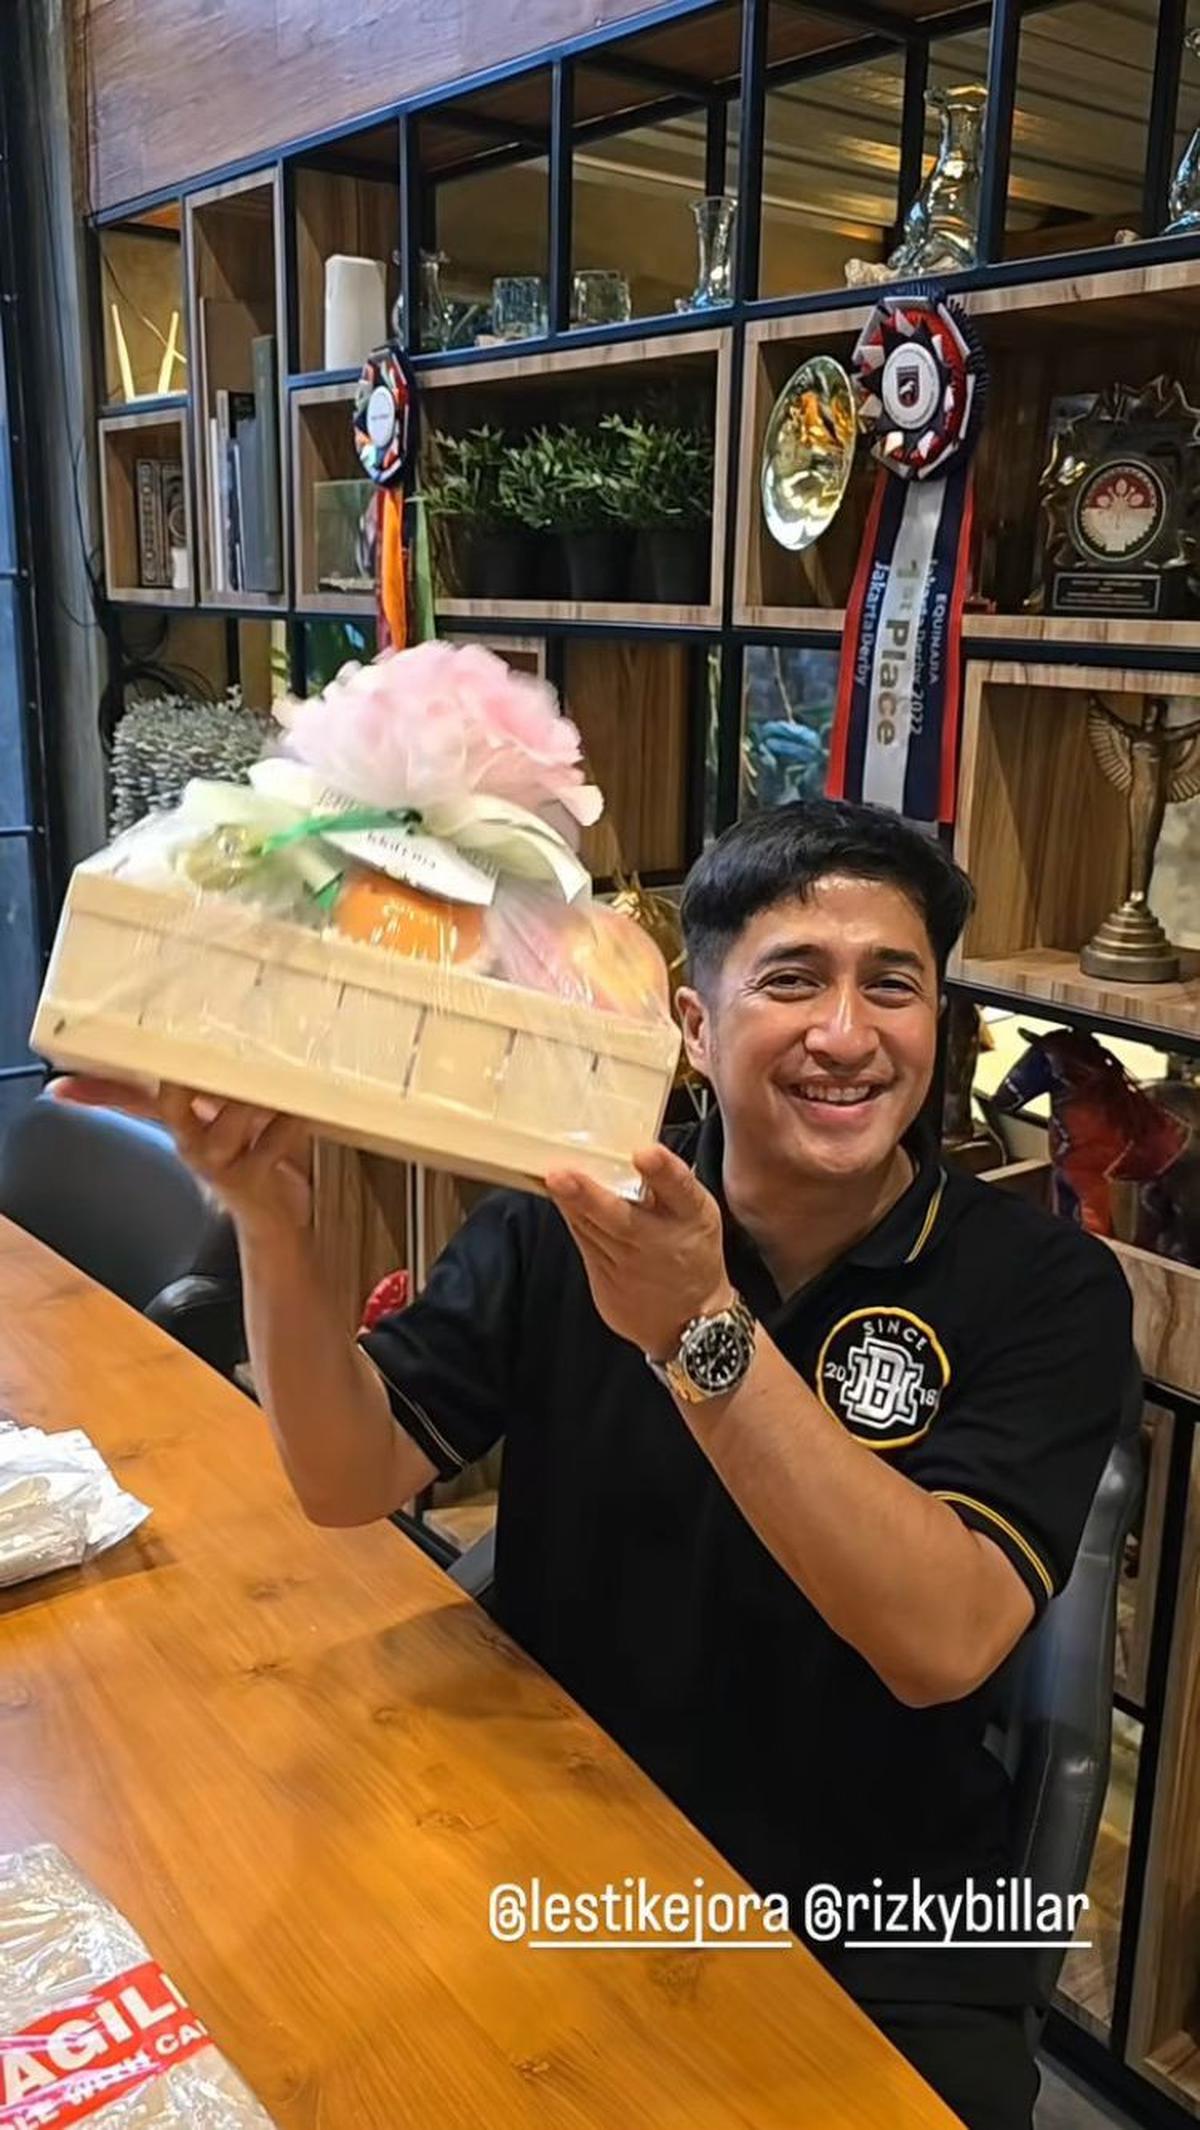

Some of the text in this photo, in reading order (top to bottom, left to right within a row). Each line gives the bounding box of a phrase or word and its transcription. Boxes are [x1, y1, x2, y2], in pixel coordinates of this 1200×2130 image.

[854, 561, 891, 687] Jakarta Derby
[877, 619, 911, 746] Place
[862, 1318, 928, 1351] SINCE
